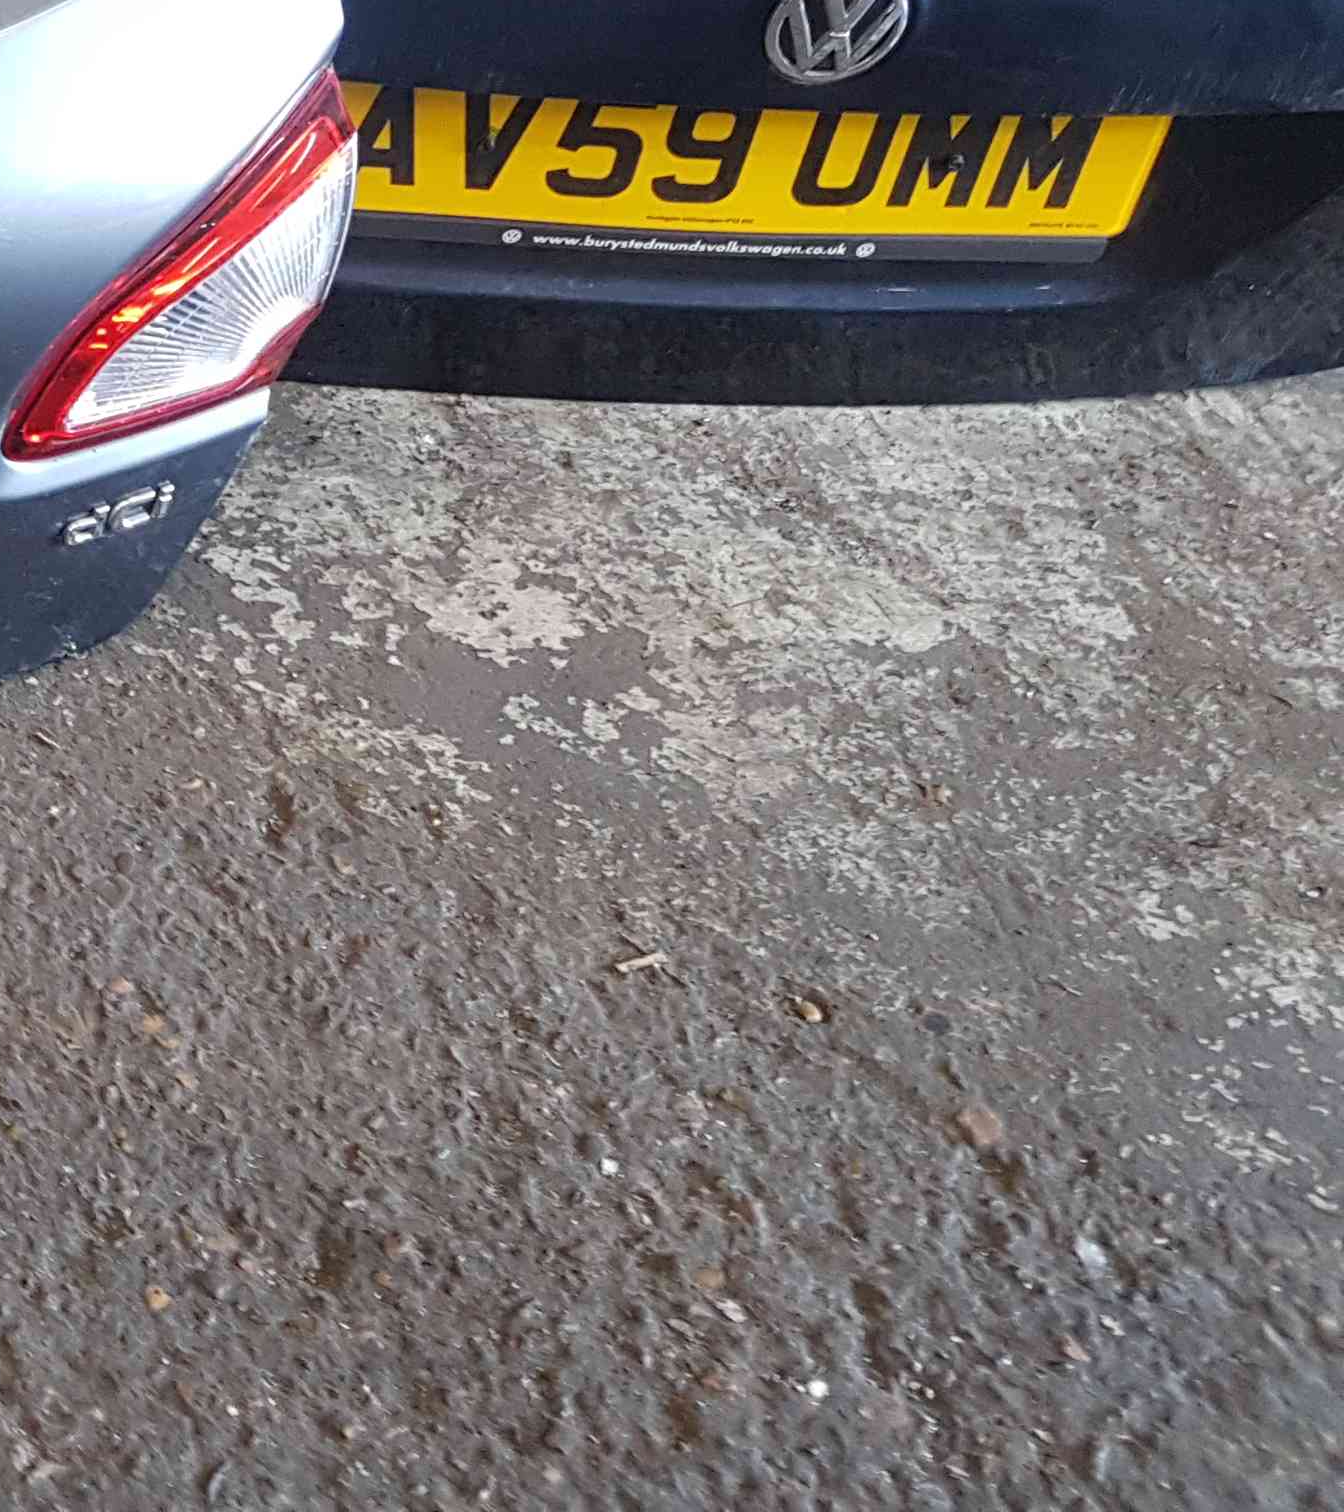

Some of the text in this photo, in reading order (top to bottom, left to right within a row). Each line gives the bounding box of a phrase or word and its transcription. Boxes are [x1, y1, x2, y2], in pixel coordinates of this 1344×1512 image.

[355, 85, 1105, 209] AV59 UMM
[532, 234, 848, 257] www.burystedmundsvolkswagen.co.uk
